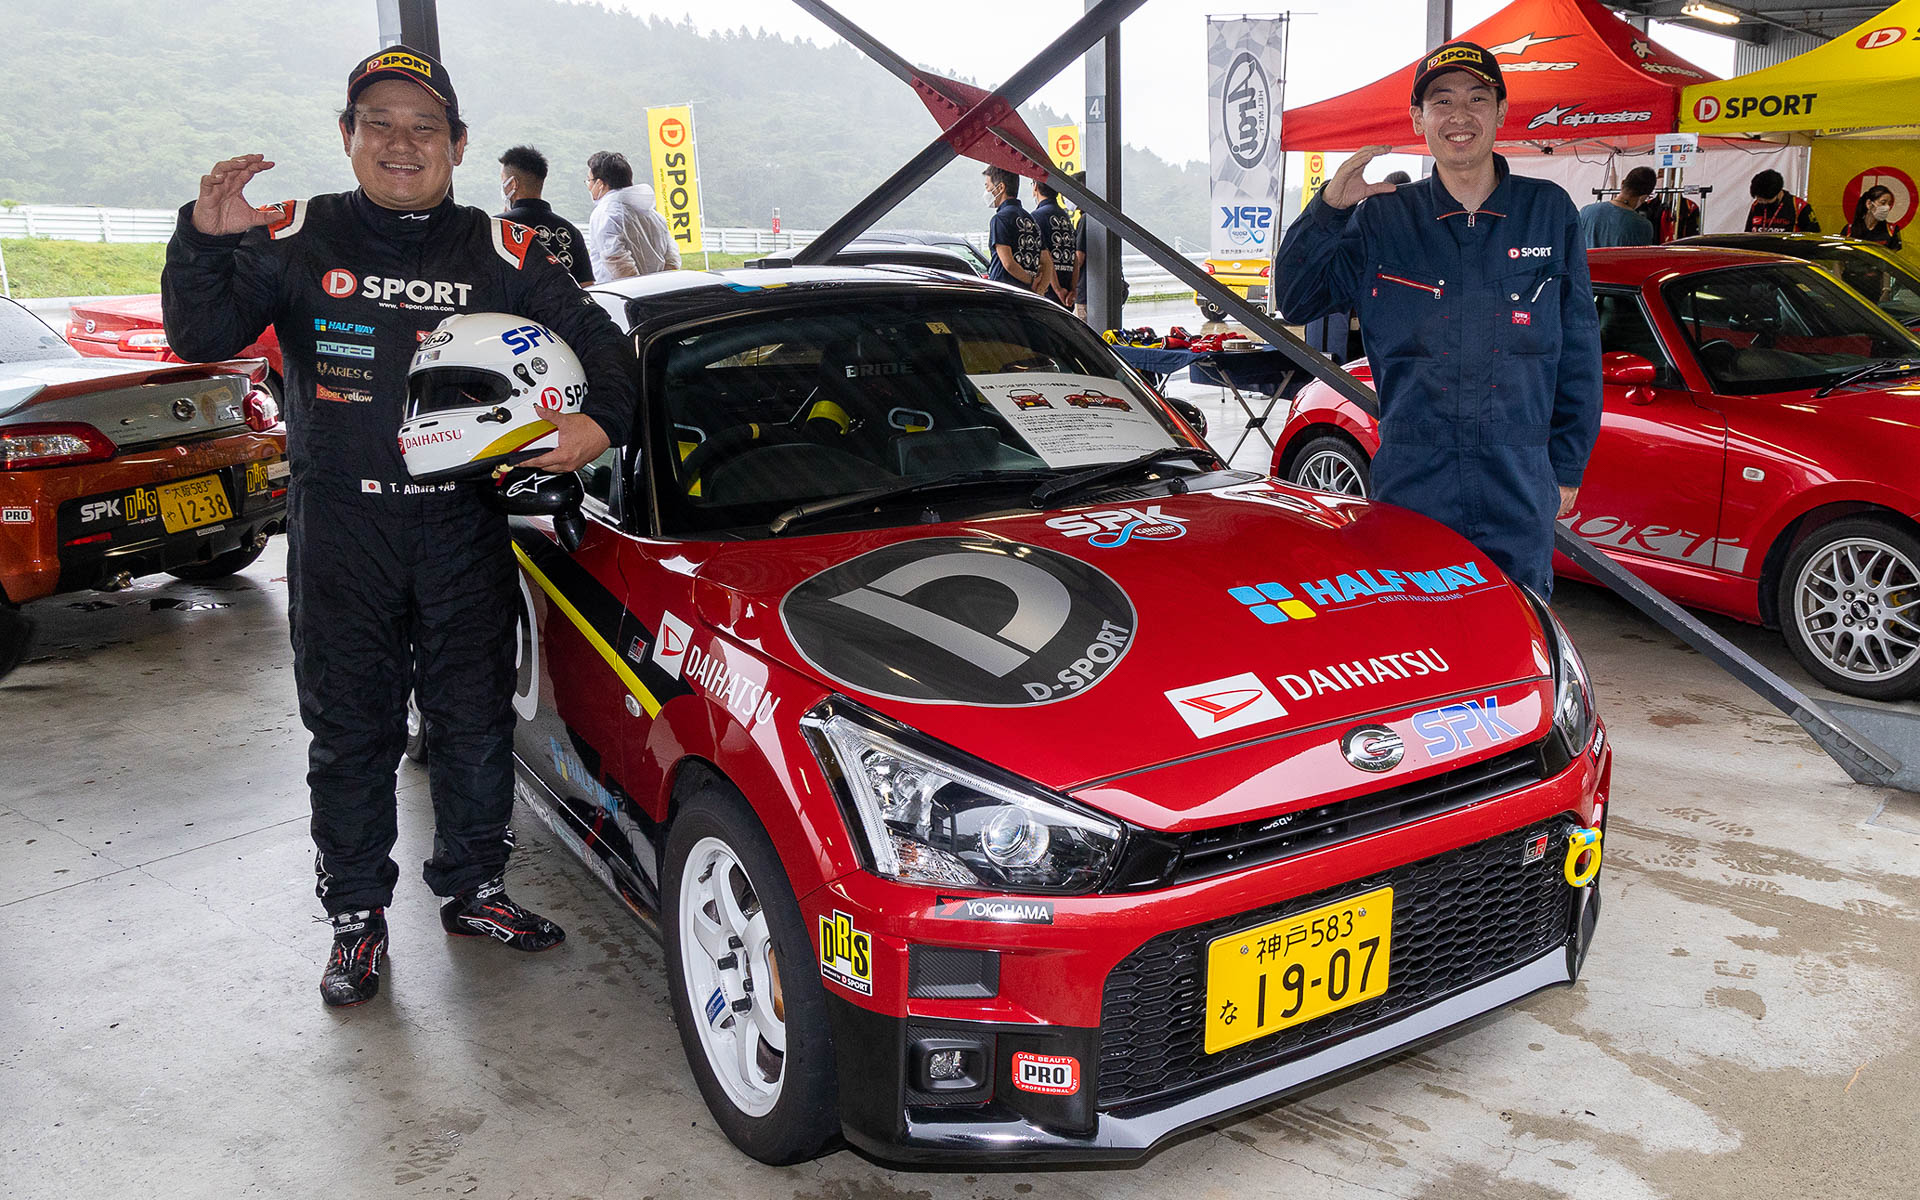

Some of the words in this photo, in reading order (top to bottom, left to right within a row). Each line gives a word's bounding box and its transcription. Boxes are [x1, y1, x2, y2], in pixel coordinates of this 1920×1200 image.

[382, 55, 429, 73] SPORT
[1440, 50, 1480, 62] SPORT
[1089, 99, 1101, 120] 4
[1725, 93, 1818, 119] SPORT
[1561, 110, 1652, 127] alpinestars
[664, 152, 692, 244] SPORT
[1520, 246, 1552, 258] SPORT
[361, 275, 473, 307] SPORT
[327, 320, 354, 332] HALF
[354, 323, 376, 335] WAY
[327, 366, 361, 379] ARIES
[845, 362, 914, 378] BRIDE
[343, 390, 373, 402] yellow
[405, 429, 462, 449] DAIHATSU
[171, 481, 208, 500] 大阪583
[389, 483, 399, 493] T.
[404, 484, 436, 495] Aihara
[5, 510, 28, 520] PRO
[80, 498, 122, 523] SPK
[125, 488, 158, 520] DRS
[178, 493, 228, 525] 12-38
[1045, 505, 1191, 538] SPK
[1299, 568, 1407, 606] HALF
[1402, 561, 1489, 594] WAY
[826, 551, 1072, 678] D
[1022, 619, 1130, 702] D-SPORT
[685, 644, 782, 726] DAIHATSU
[1276, 648, 1450, 702] DAIHATSU
[1411, 695, 1521, 759] SPK
[966, 901, 1050, 921] YOKOHAMA
[822, 914, 869, 977] DRS
[1255, 909, 1354, 965] 神戸583
[847, 978, 869, 992] SPORT
[1255, 935, 1381, 1029] 19-07
[1218, 999, 1238, 1027] な
[1017, 1053, 1035, 1061] CAR
[1037, 1056, 1072, 1064] BEAUTY
[1024, 1063, 1065, 1085] PRO
[1021, 1084, 1070, 1094] PROFESSIONAL
